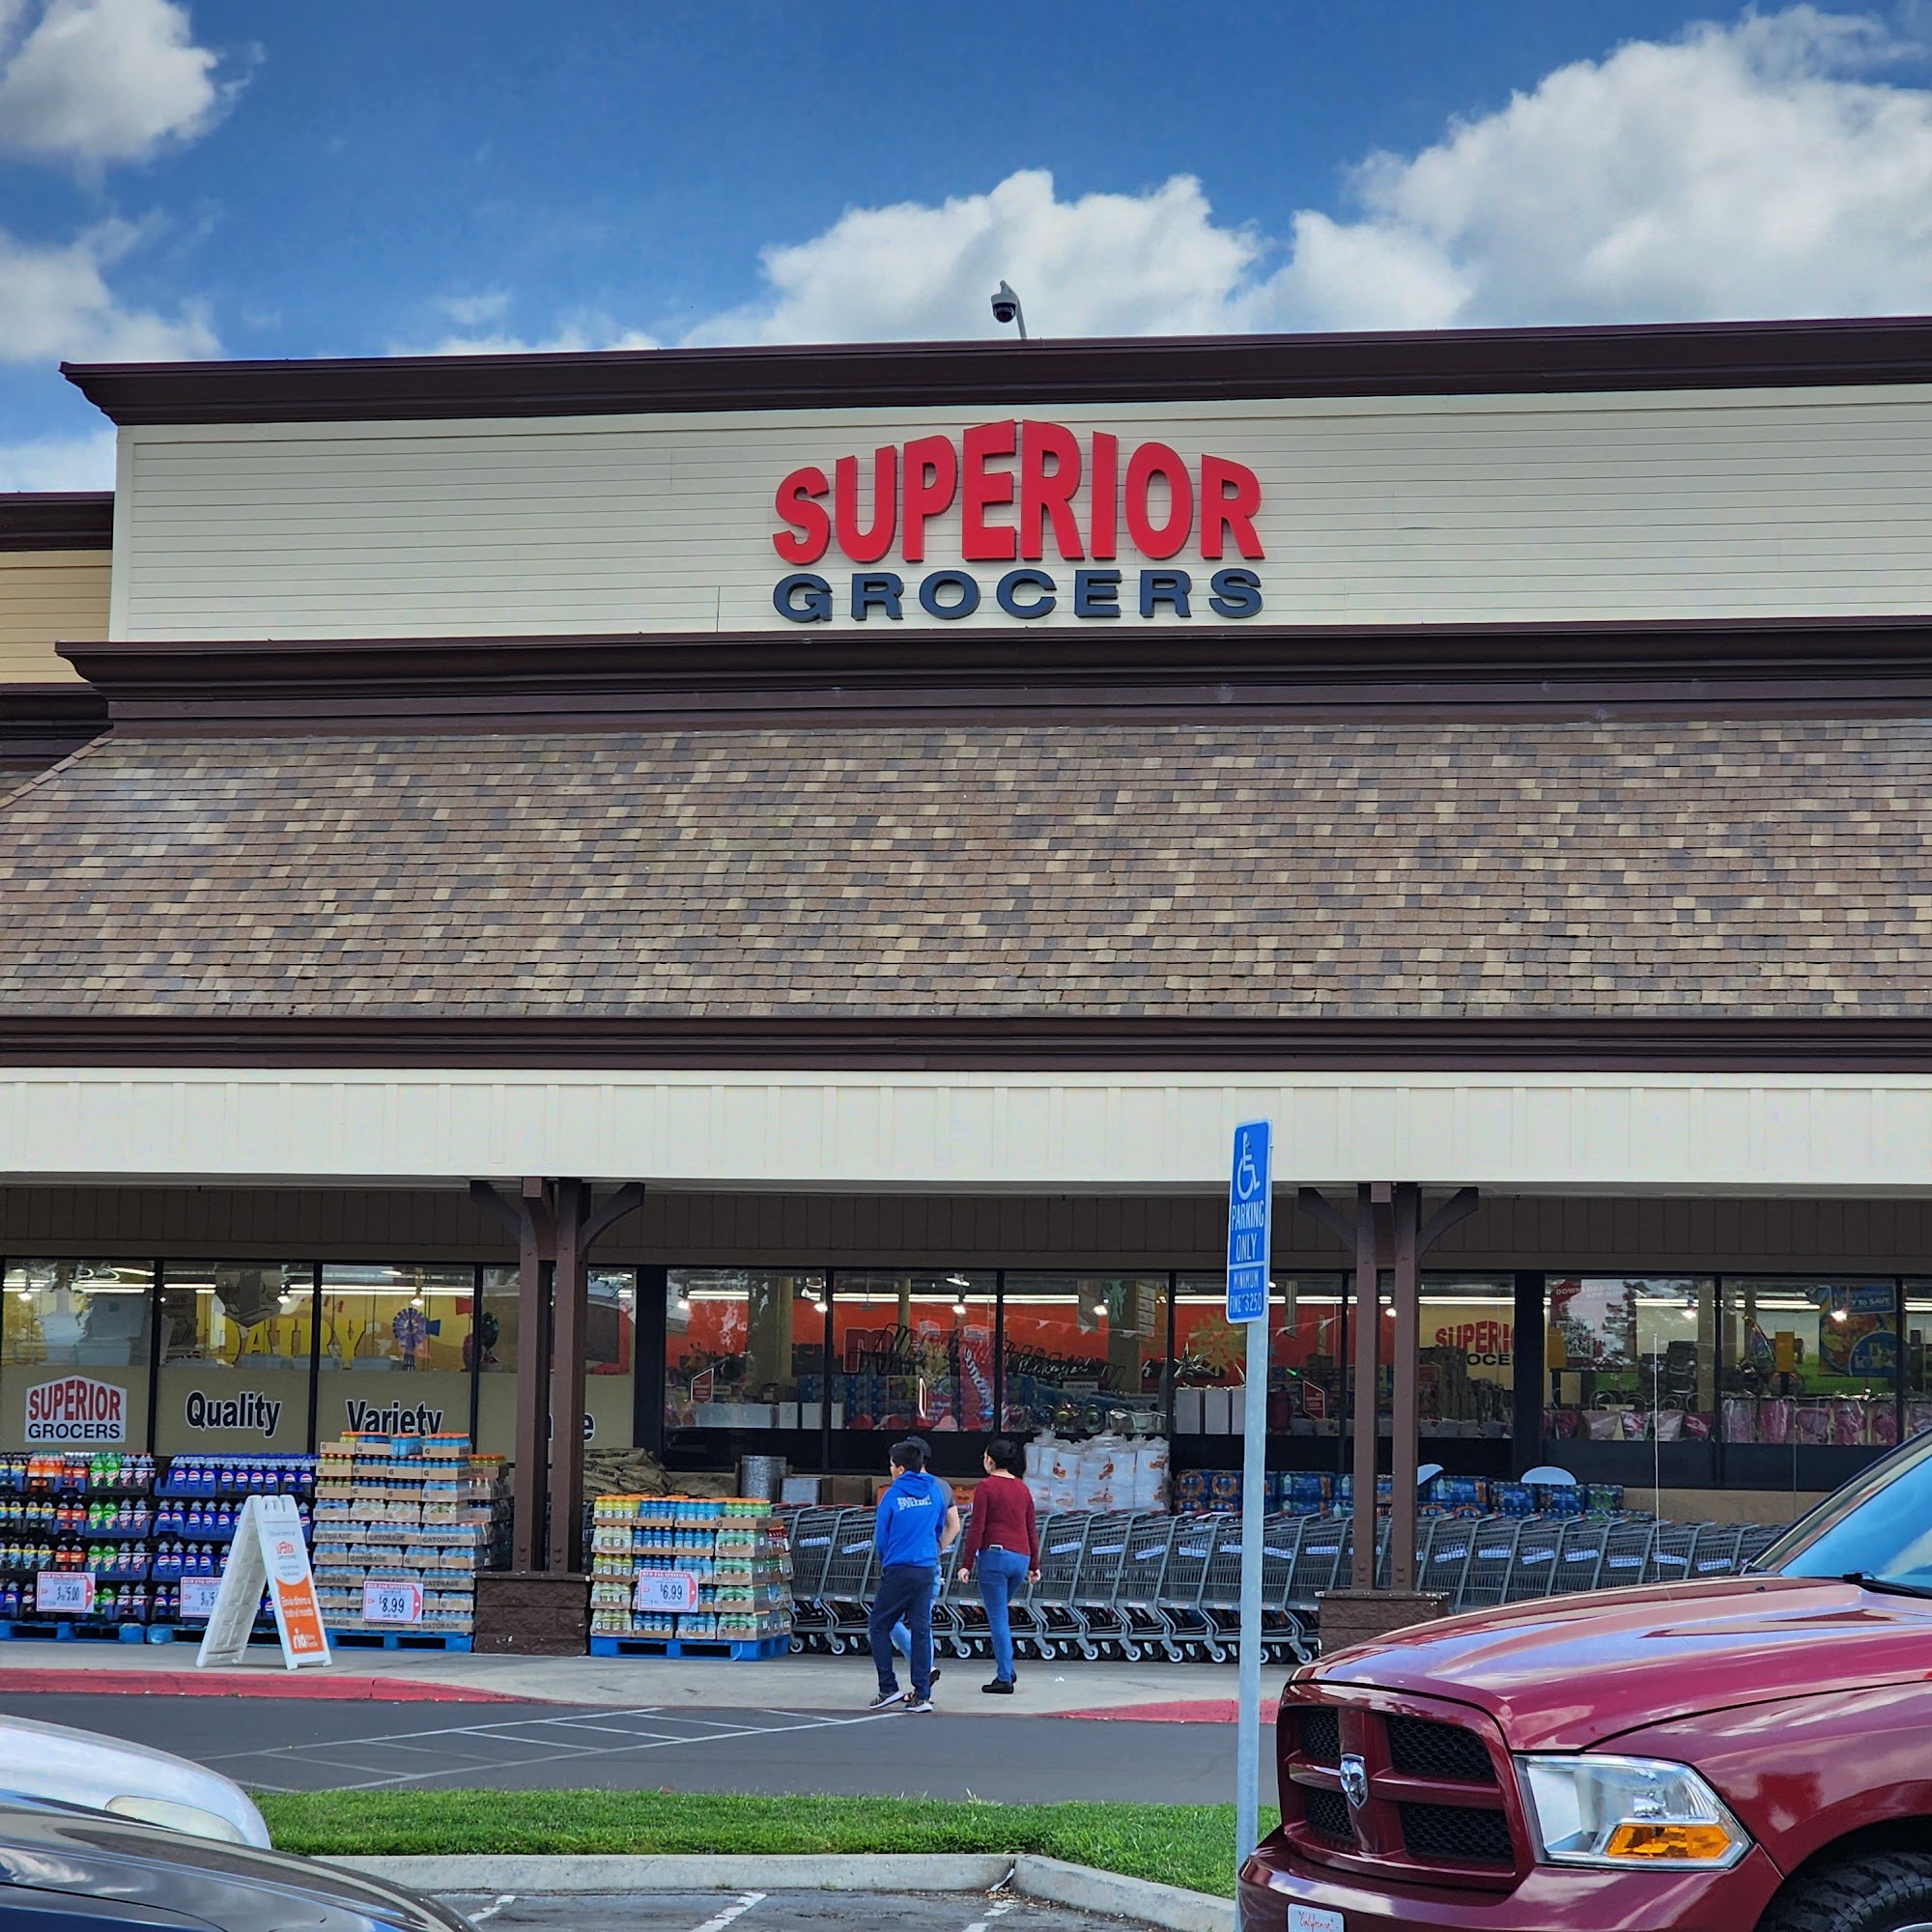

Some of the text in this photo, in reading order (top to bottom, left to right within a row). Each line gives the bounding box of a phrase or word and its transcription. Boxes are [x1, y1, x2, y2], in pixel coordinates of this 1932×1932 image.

[772, 418, 1265, 565] SUPERIOR
[772, 568, 1263, 623] GROCERS
[1231, 1200, 1264, 1232] PARKING
[1236, 1233, 1257, 1262] ONLY
[1233, 1269, 1260, 1291] MINIMUM
[1229, 1294, 1242, 1314] FINE
[1435, 1321, 1514, 1354] SUPERI
[28, 1378, 121, 1421] SUPERIOR
[185, 1390, 282, 1438] Quality
[28, 1423, 120, 1438] GROCERS
[345, 1399, 443, 1437] Variety
[379, 1594, 405, 1613] $8.99
[660, 1583, 683, 1600] $6.99
[293, 1627, 306, 1650] ria
